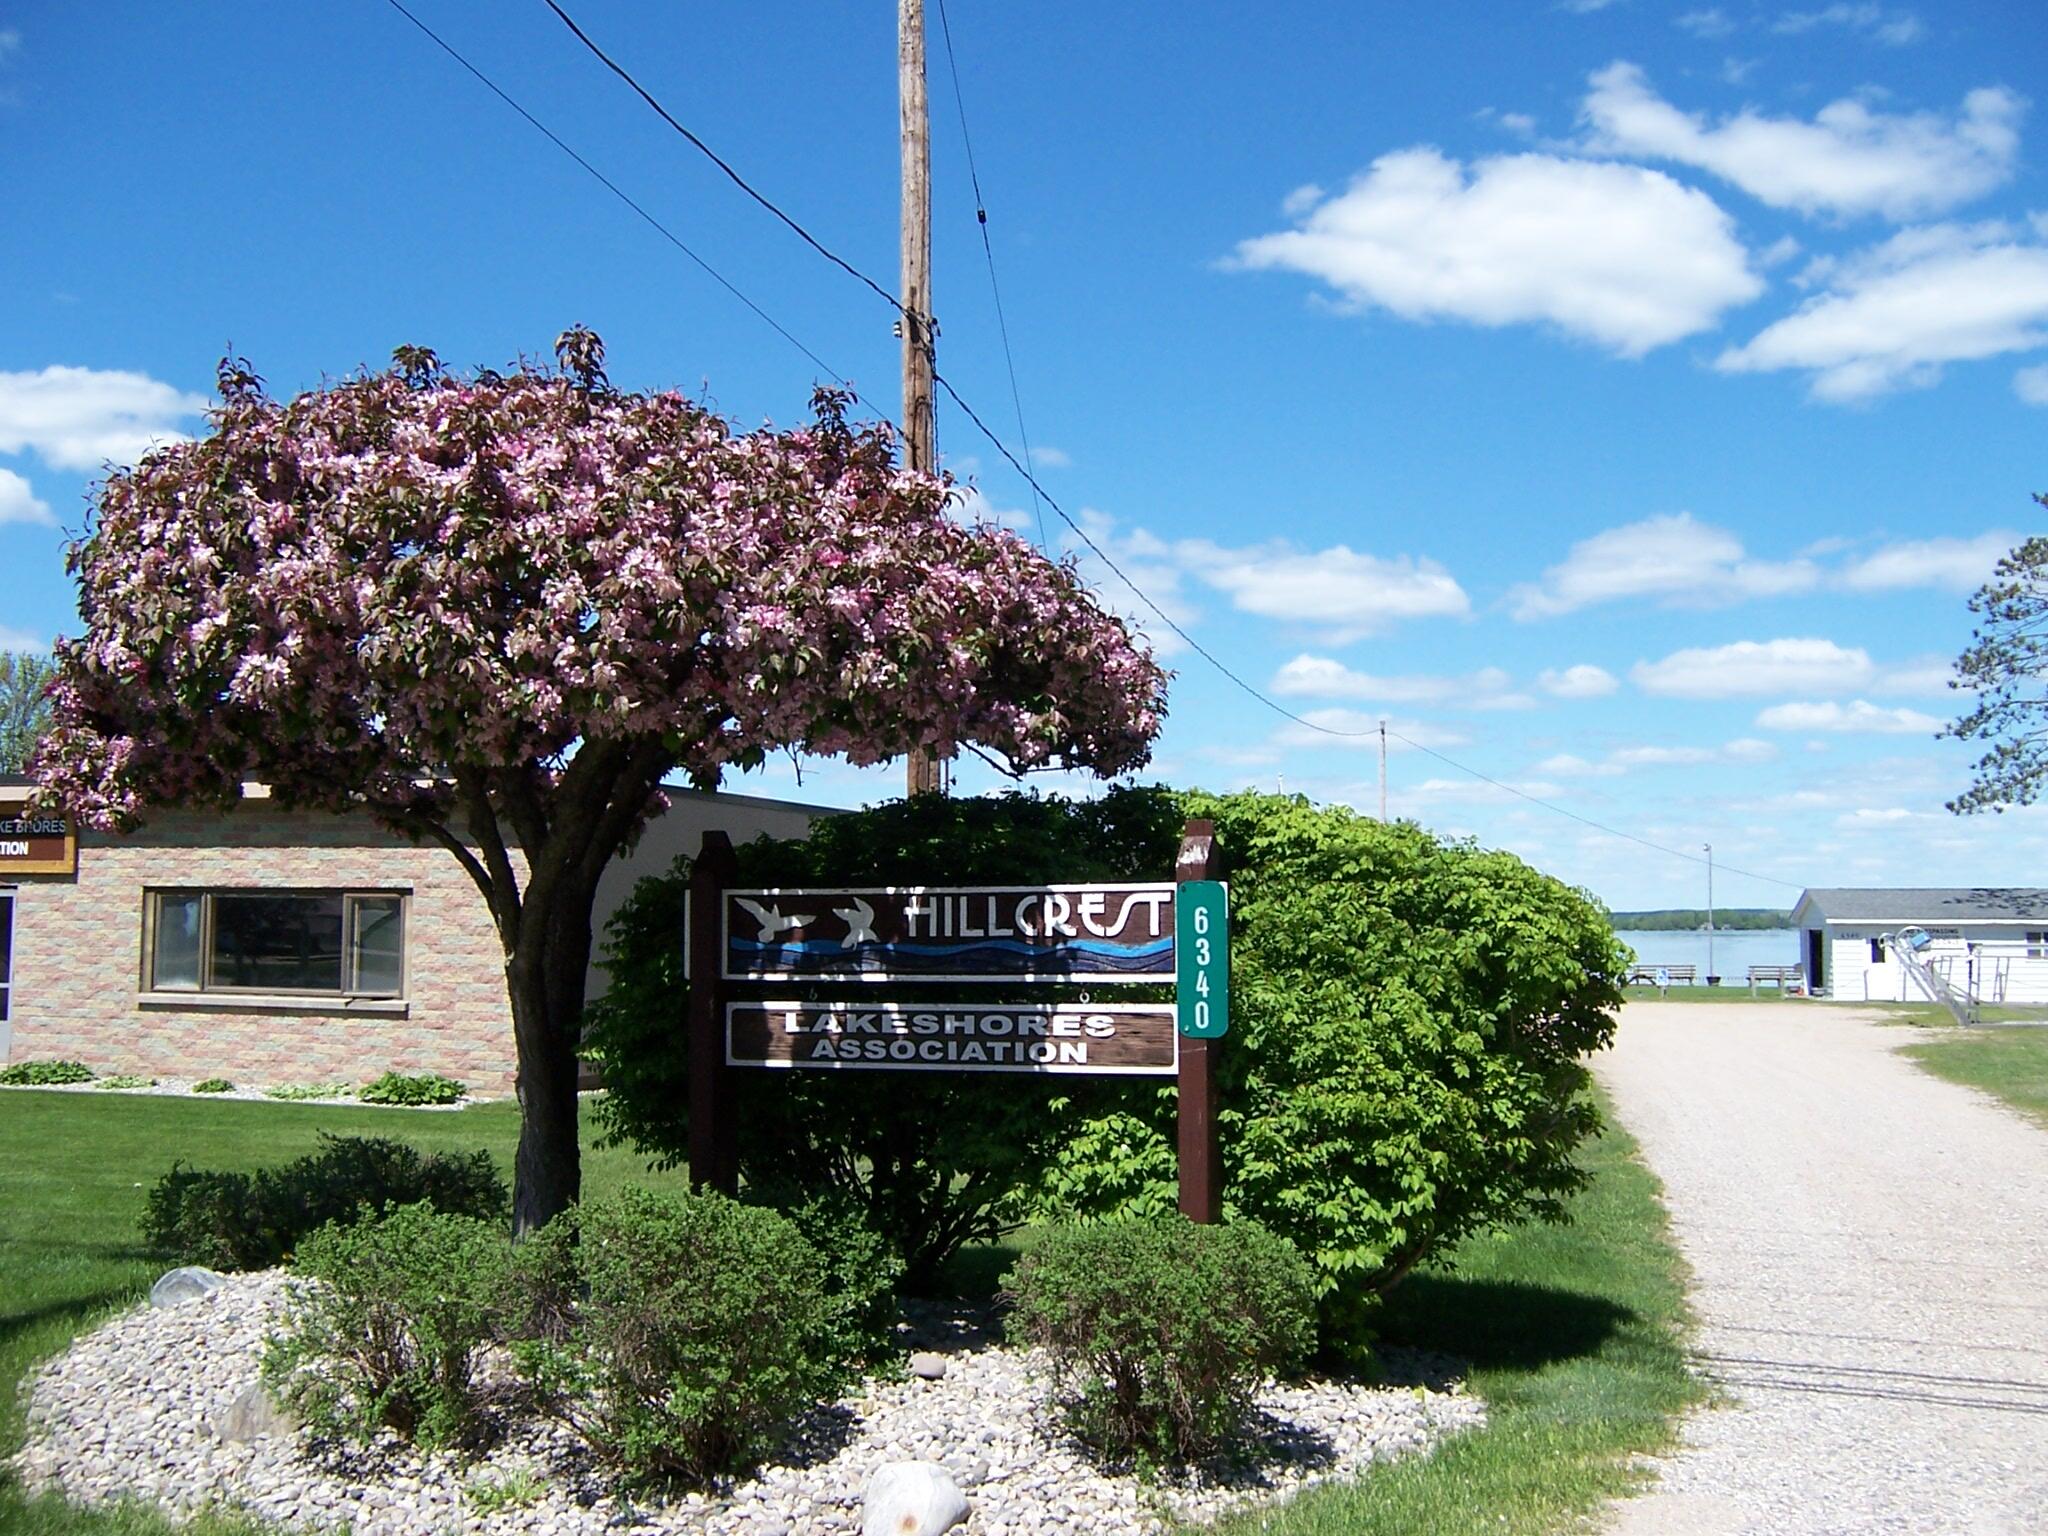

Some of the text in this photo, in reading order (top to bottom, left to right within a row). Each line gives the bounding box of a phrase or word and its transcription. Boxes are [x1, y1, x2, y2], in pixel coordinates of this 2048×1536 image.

[904, 890, 1172, 937] HILLCREST
[1194, 906, 1211, 1029] 6340
[784, 1012, 1116, 1037] LAKESHORES
[811, 1039, 1088, 1064] ASSOCIATION
